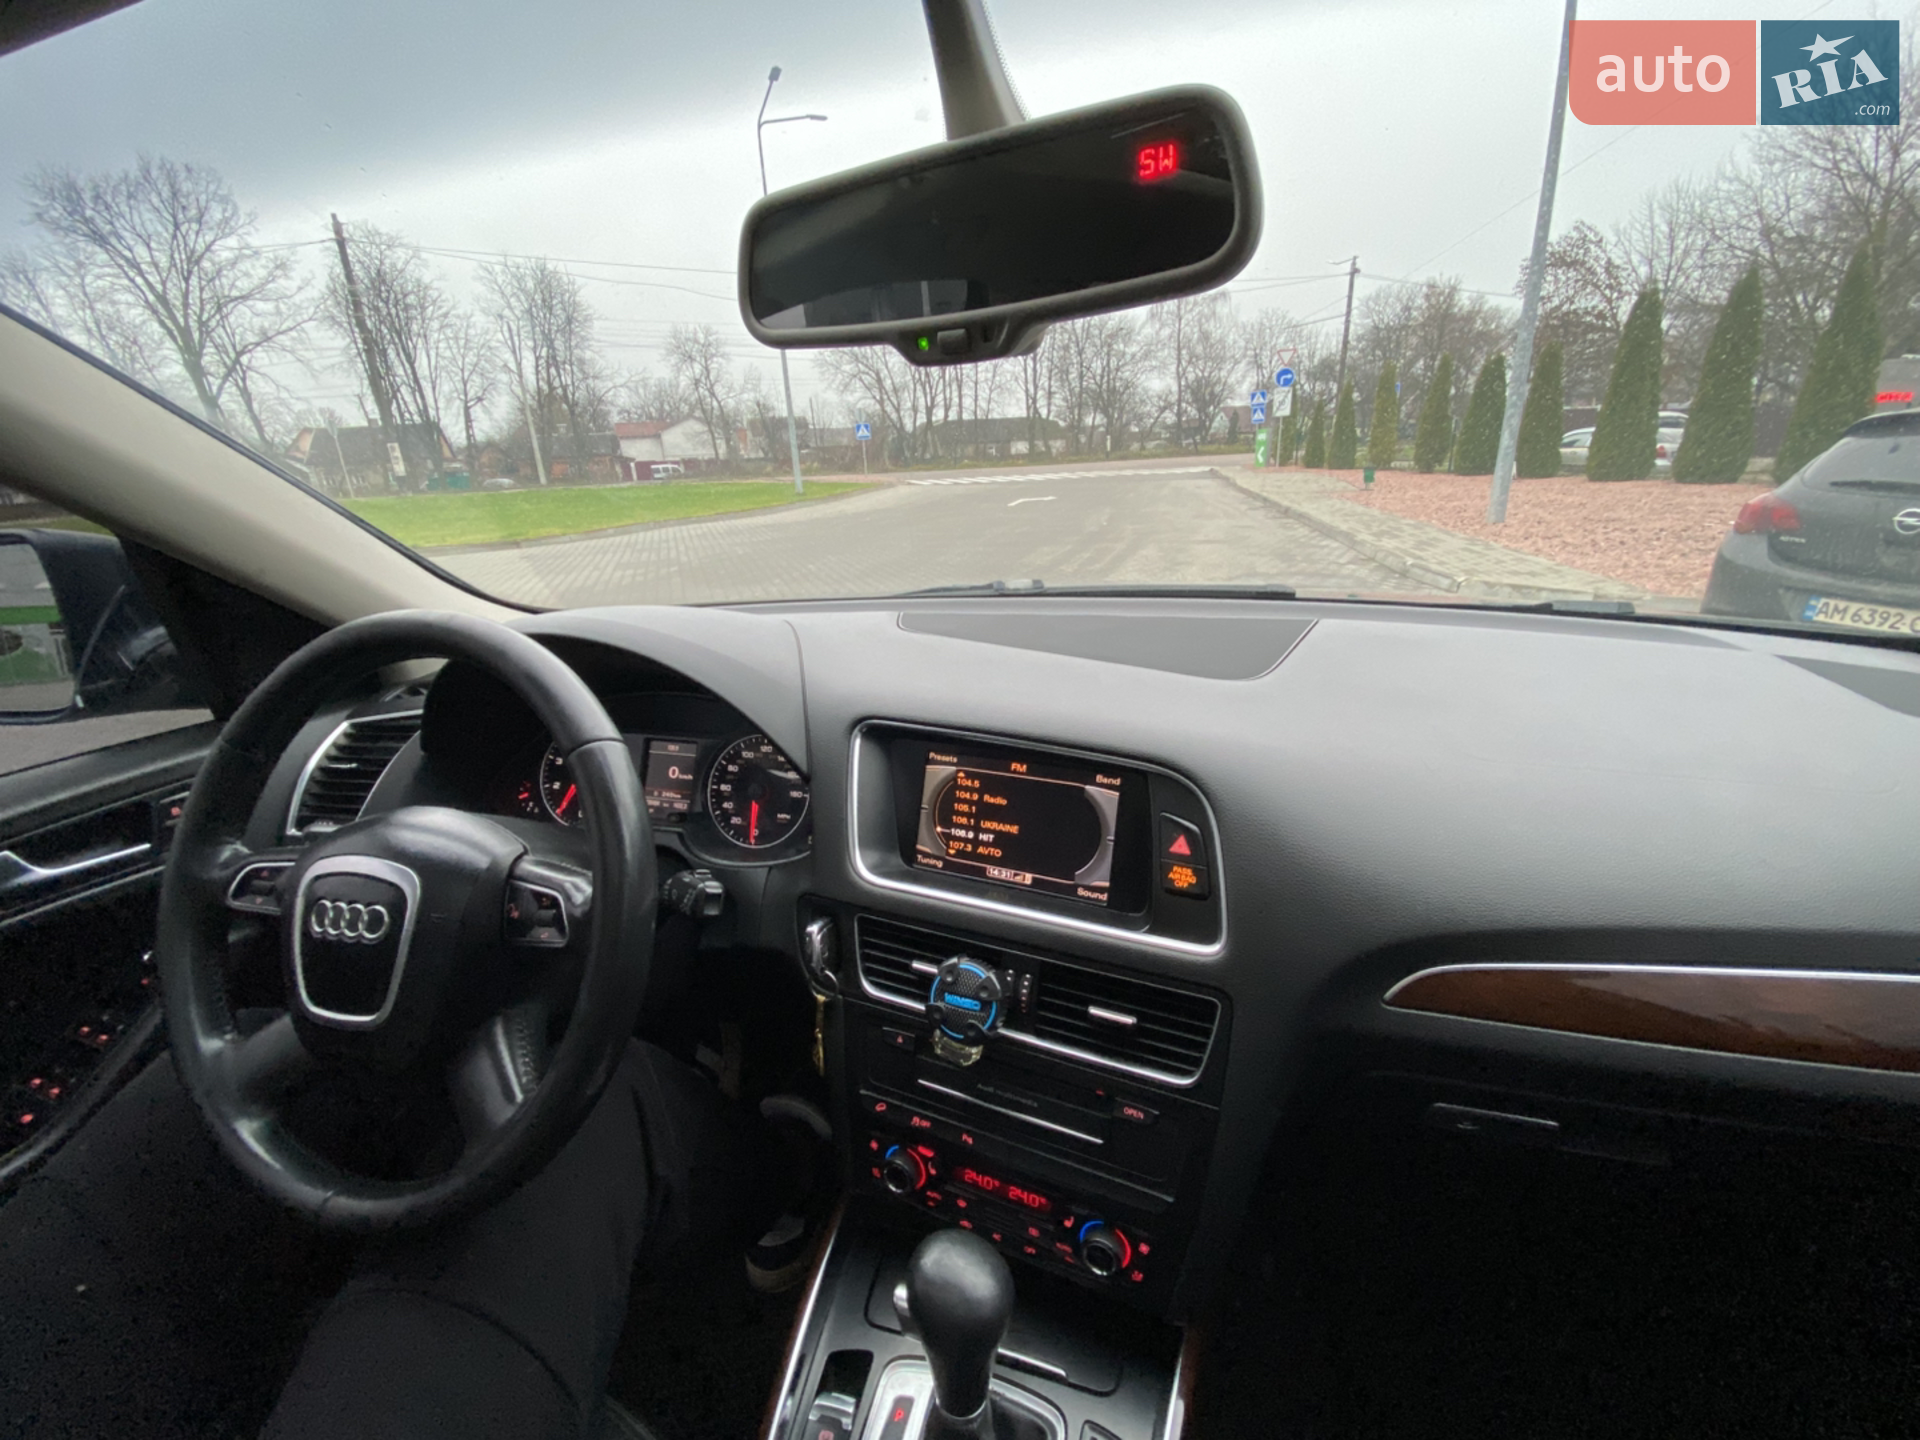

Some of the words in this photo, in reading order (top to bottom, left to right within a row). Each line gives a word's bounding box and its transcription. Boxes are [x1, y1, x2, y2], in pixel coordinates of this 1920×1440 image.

[1139, 144, 1174, 177] SW
[929, 752, 958, 763] Presets
[1011, 762, 1028, 773] FM
[1096, 774, 1121, 786] Band
[957, 778, 980, 788] 104.5
[955, 790, 979, 801] 104.9
[983, 794, 1008, 806] Radio
[980, 820, 1020, 834] UKRAINE
[978, 832, 995, 842] HIT
[949, 840, 972, 851] 107.3
[977, 846, 1002, 857] AVTO
[916, 854, 944, 868] Tuning
[1077, 887, 1108, 901] Sound
[1123, 1106, 1144, 1119] OPEN
